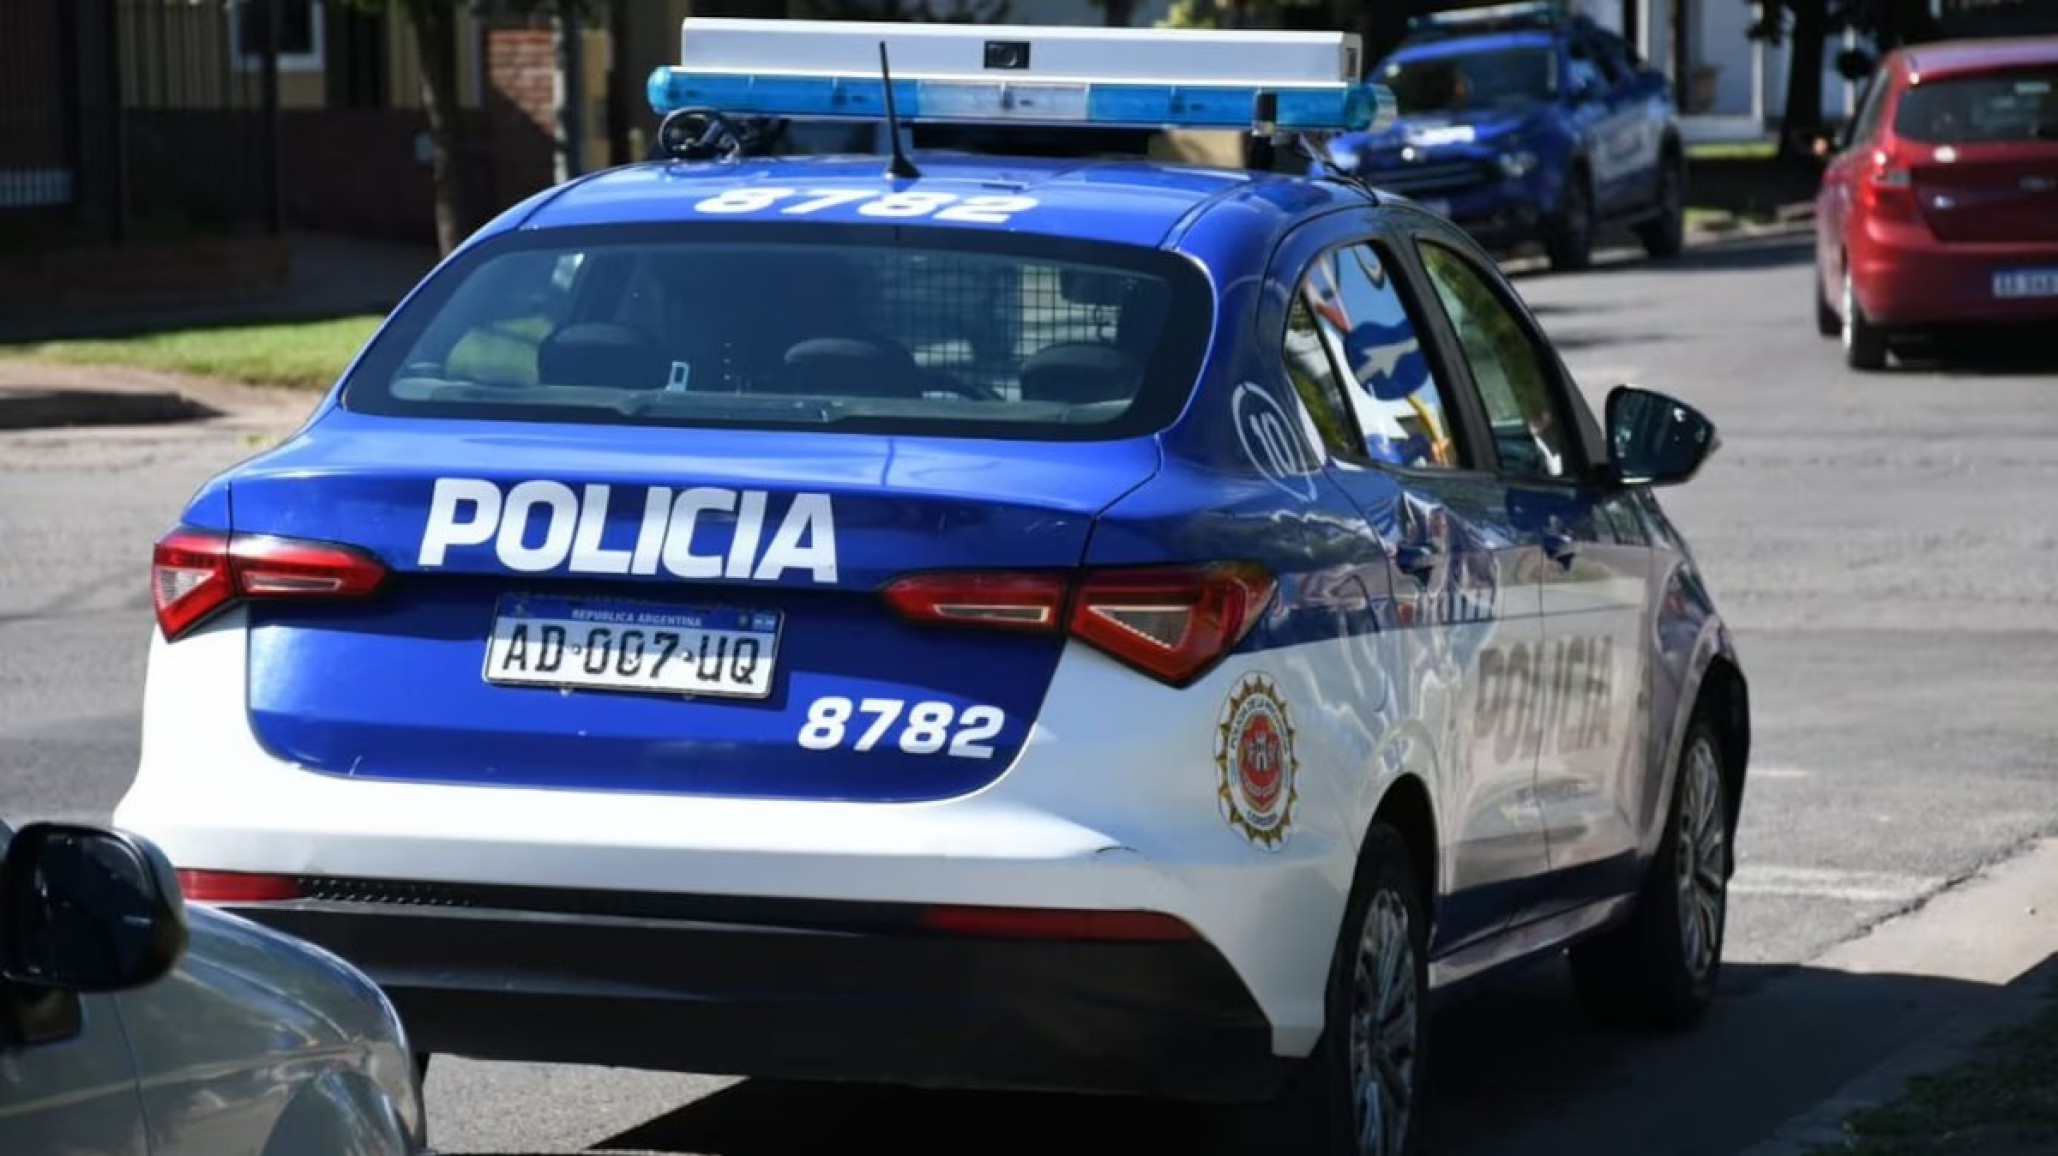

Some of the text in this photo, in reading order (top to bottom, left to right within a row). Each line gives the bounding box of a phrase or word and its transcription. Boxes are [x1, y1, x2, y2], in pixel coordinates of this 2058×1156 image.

[694, 188, 1039, 223] 8782
[1249, 412, 1297, 478] 10
[417, 477, 838, 583] POLICIA
[637, 611, 703, 627] ARGENTINA
[502, 623, 566, 672] AD
[797, 696, 1005, 758] 8782
